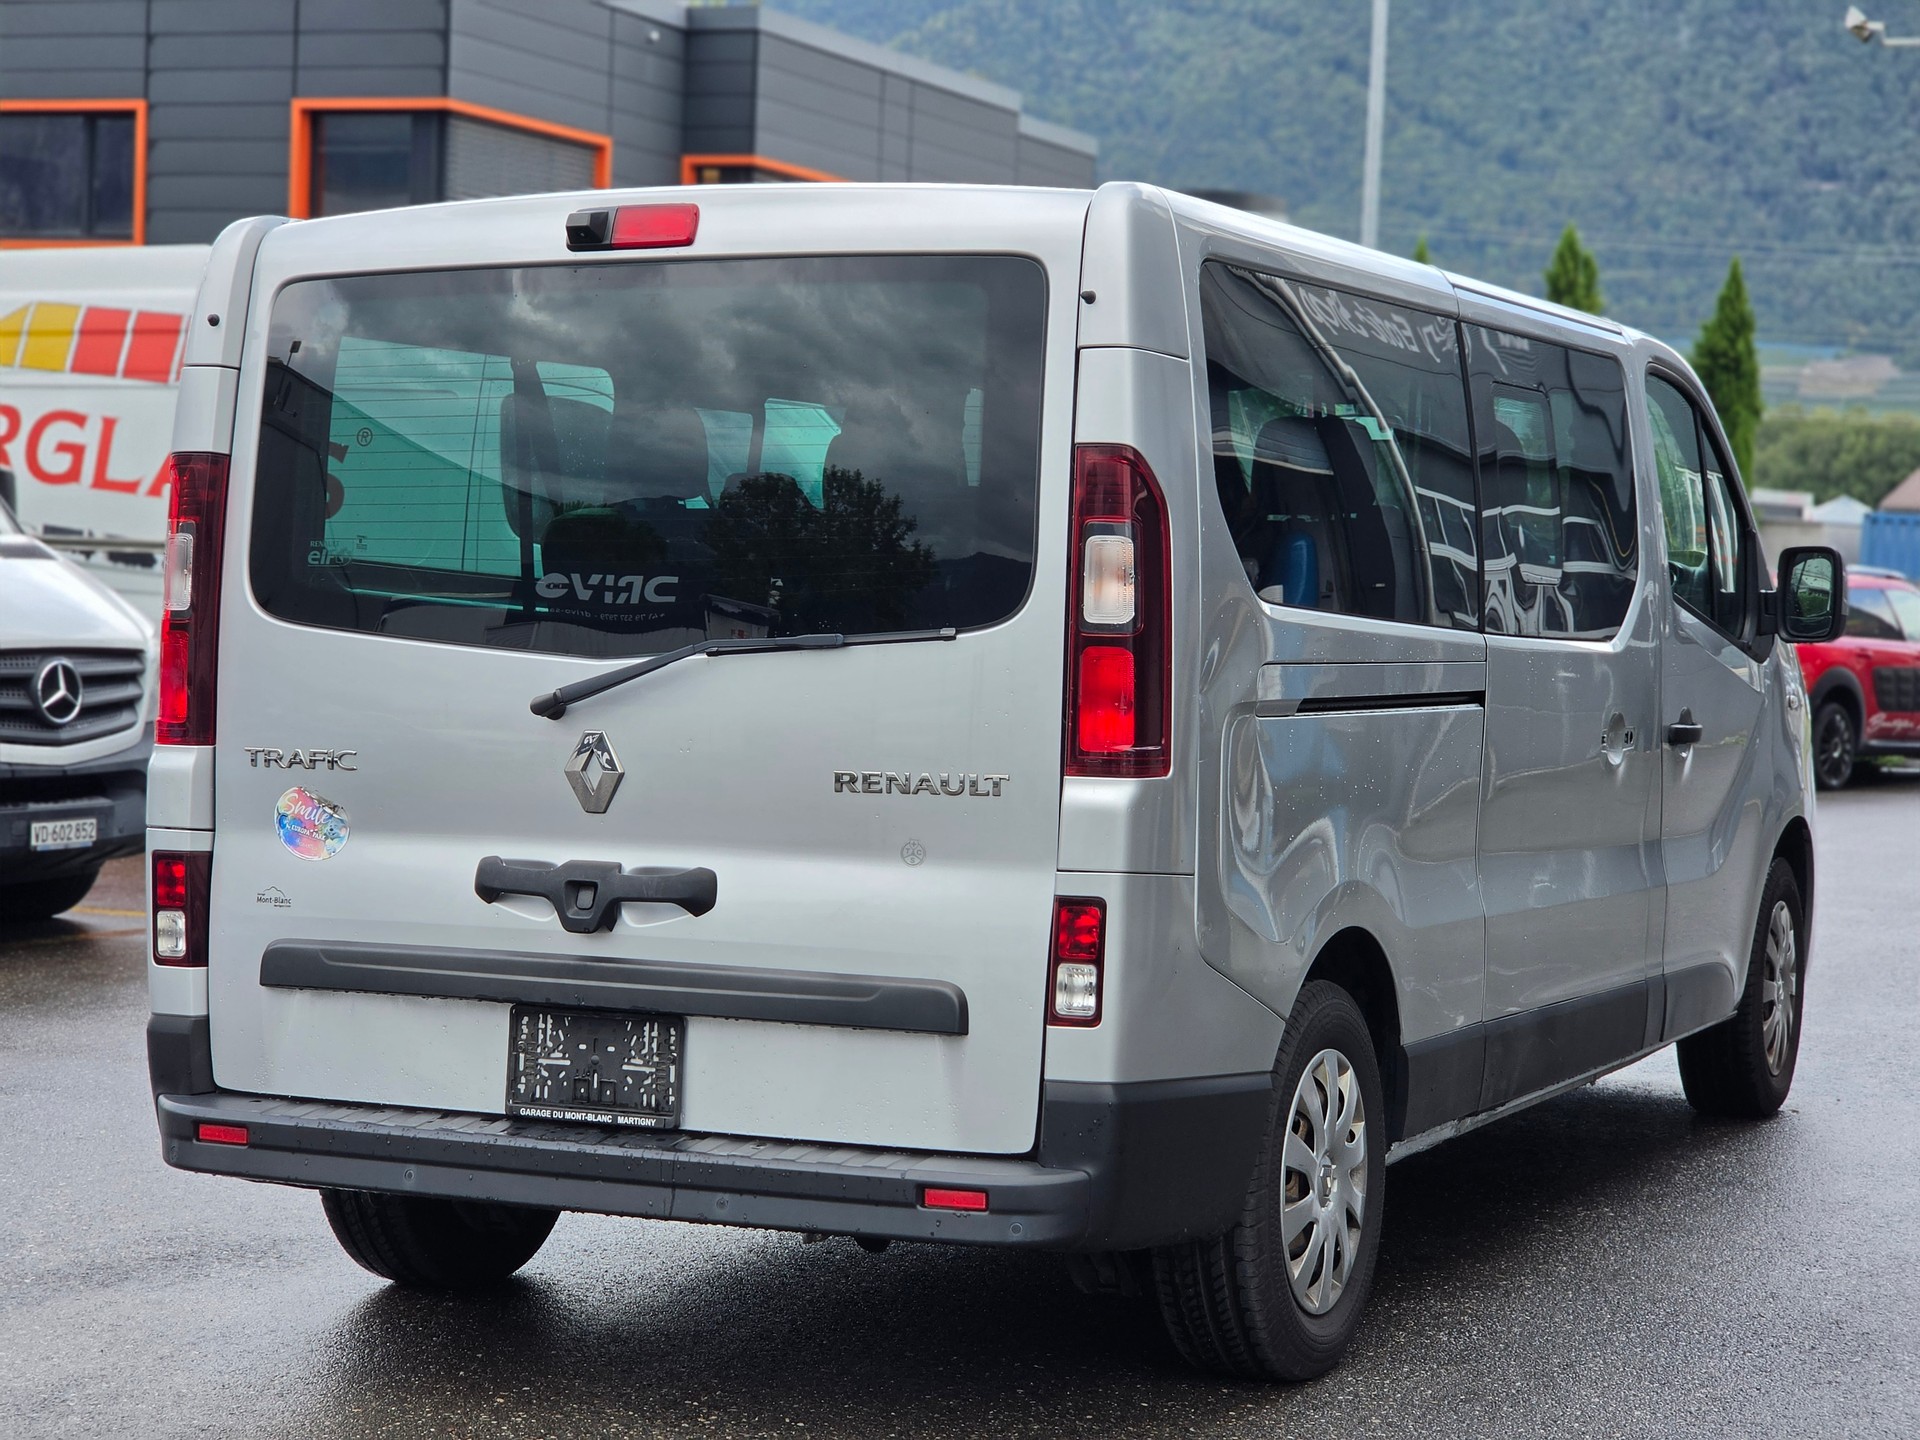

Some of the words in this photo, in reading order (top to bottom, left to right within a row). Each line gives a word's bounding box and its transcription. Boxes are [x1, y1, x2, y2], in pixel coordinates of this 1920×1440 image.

[244, 746, 357, 771] TRAFIC
[833, 770, 1010, 797] RENAULT
[278, 792, 333, 825] Smile
[34, 825, 48, 843] VD
[291, 824, 310, 836] EUROPA
[256, 896, 292, 905] Mont-Blanc
[520, 1107, 551, 1118] GARAGE
[553, 1110, 564, 1119] DU
[565, 1111, 613, 1123] MONT-BLANC
[617, 1115, 656, 1127] MARTIGNY
